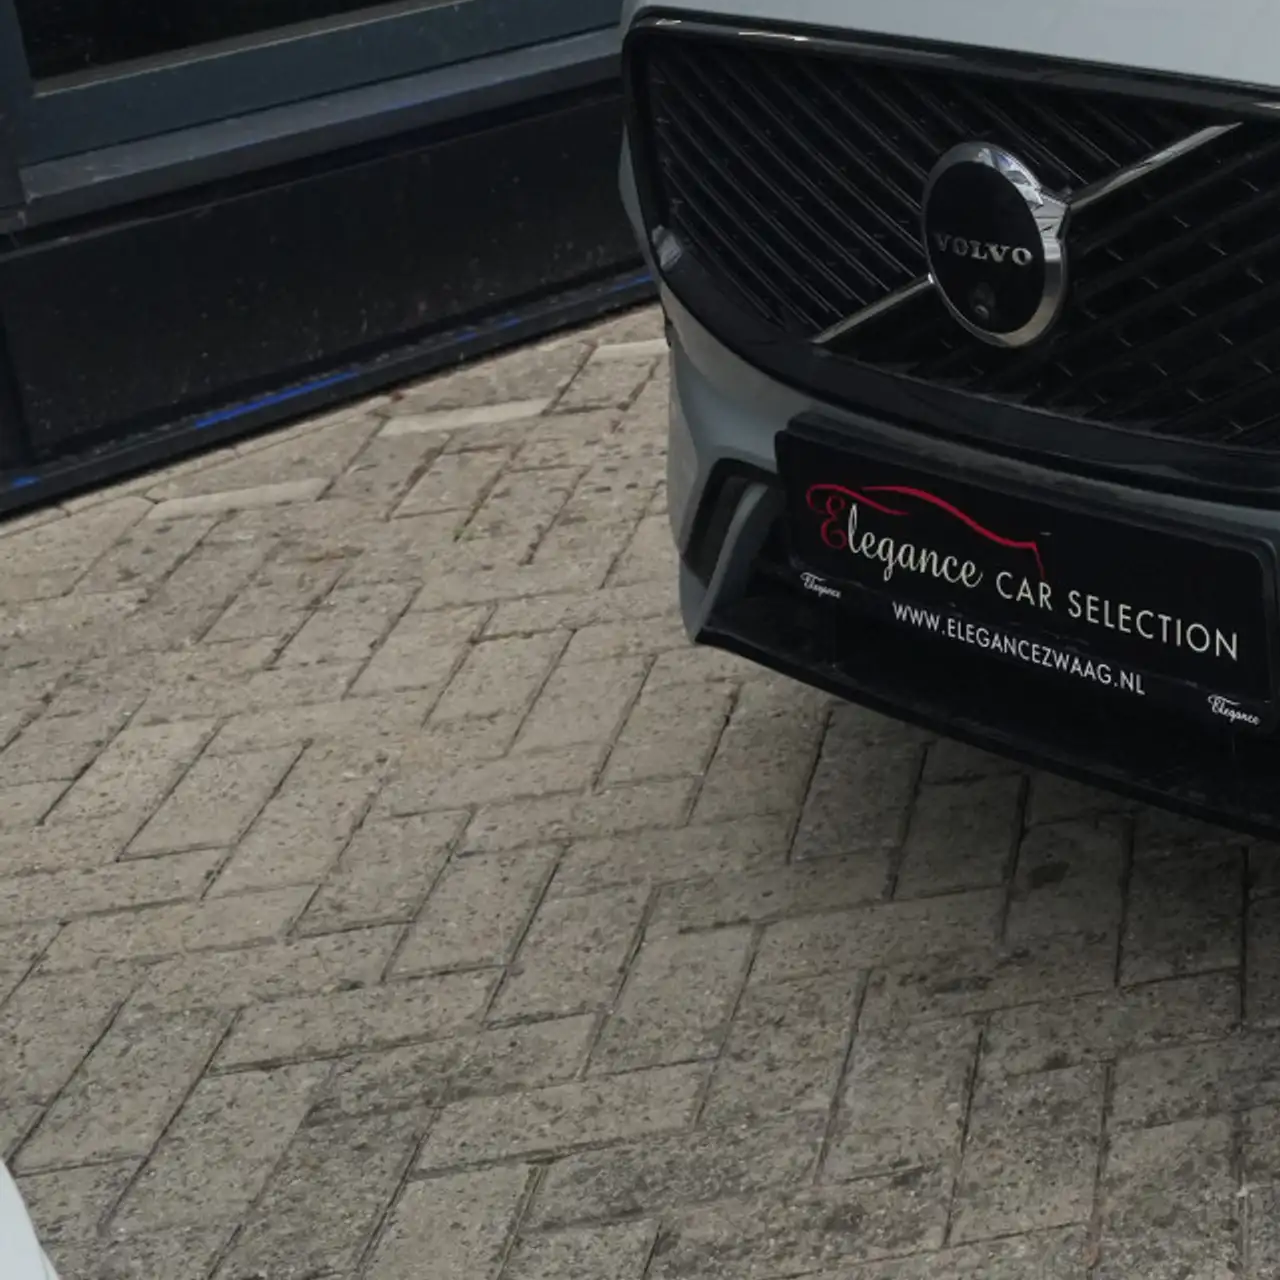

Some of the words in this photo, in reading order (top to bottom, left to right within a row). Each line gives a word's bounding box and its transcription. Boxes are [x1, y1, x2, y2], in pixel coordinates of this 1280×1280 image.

[934, 232, 1034, 267] VOLVO
[820, 494, 984, 589] Elegance
[995, 570, 1054, 612] CAR
[1067, 589, 1240, 663] SELECTION
[892, 600, 1147, 697] WWW.ELEGANCEZWAAG.NL
